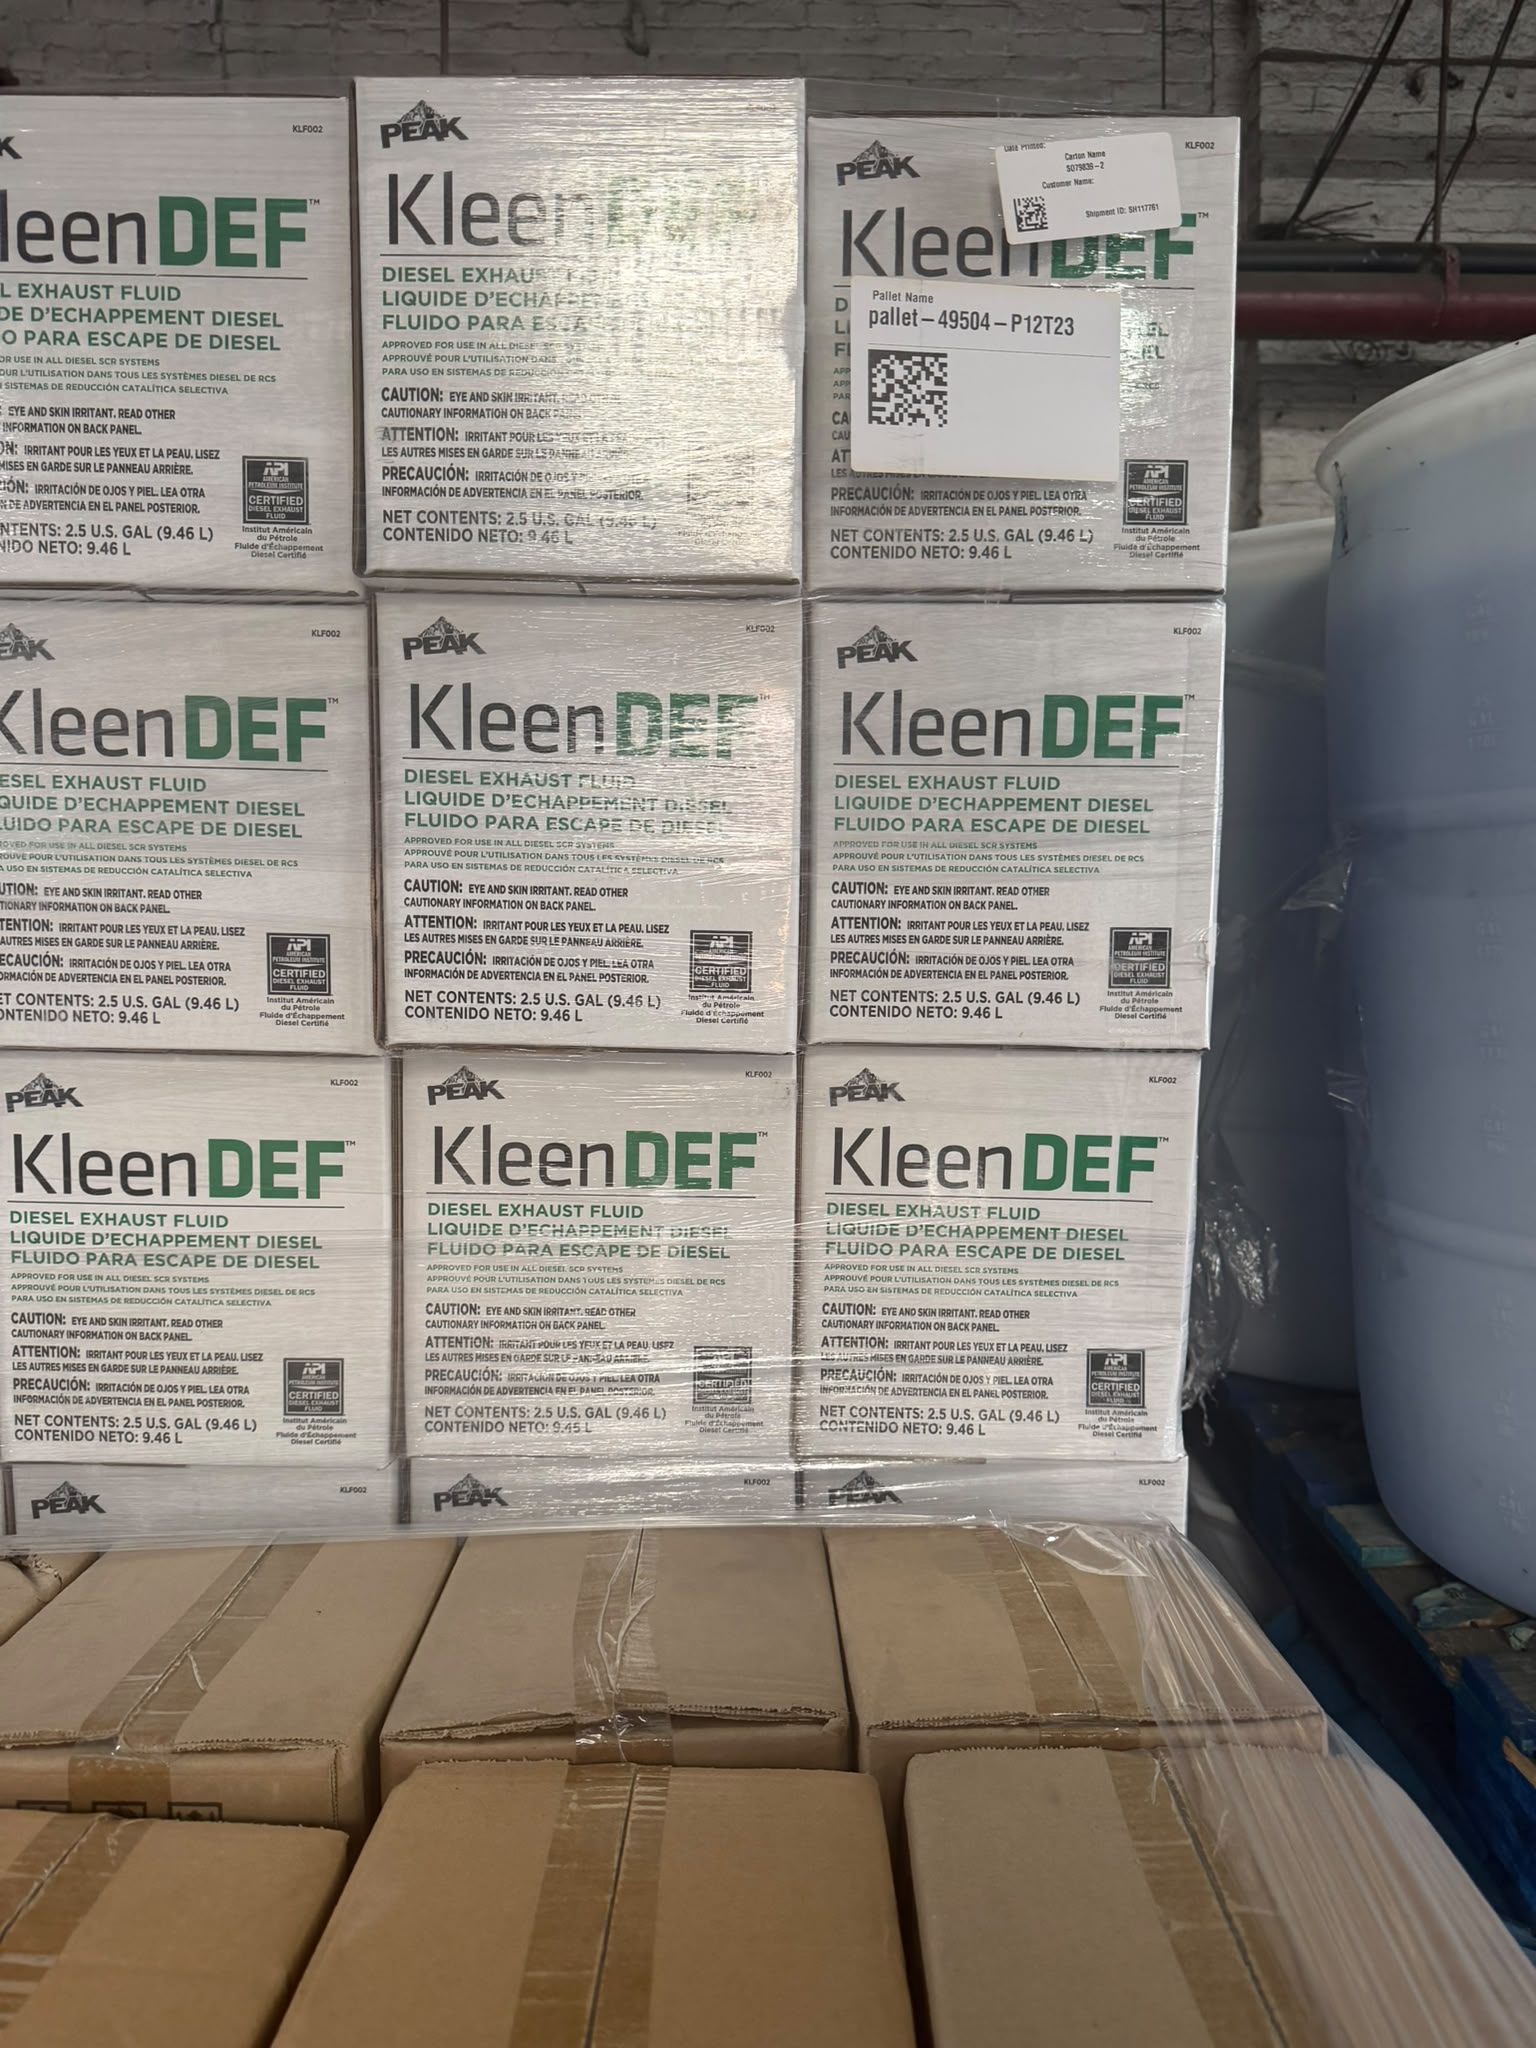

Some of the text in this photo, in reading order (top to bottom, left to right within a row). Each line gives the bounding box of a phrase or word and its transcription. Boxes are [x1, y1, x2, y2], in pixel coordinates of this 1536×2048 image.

[292, 124, 323, 133] KLF002
[380, 114, 469, 149] PEAK
[1184, 141, 1214, 149] KLF002
[1064, 150, 1105, 160] Carton Name
[836, 155, 921, 186] PEAK
[1041, 180, 1071, 189] Customer
[1085, 203, 1159, 218] Shipment ID: SH117761
[382, 266, 454, 282] DIESEL
[17, 283, 180, 301] EXHAUST FLUID
[382, 290, 467, 306] LIQUIDE
[872, 289, 934, 304] Pallet Name
[30, 306, 283, 327] D'ECHAPPEMENT DIESEL
[382, 313, 460, 330] FLUIDO
[467, 314, 525, 331] PARA
[23, 329, 280, 350] PARA ESCAPE DE DIESEL
[380, 386, 443, 401] CAUTION:
[381, 426, 458, 441] ATTENTION:
[264, 462, 288, 476] API
[381, 463, 468, 481] PRECAUCIÓN:
[248, 494, 304, 506] CERTIFIED
[382, 509, 501, 525] NET CONTENTS:
[830, 527, 1094, 546] NET CONTENTS: 2.5 U.S. GAL (9.46 L)
[829, 544, 1012, 559] CONTENIDO NETO: 9.46 L
[311, 629, 340, 637] KLF002
[1173, 627, 1201, 635] KLF002
[402, 631, 487, 660] PEAK
[836, 639, 918, 669] PEAK
[51, 775, 206, 792] EXHAUST FLUID
[404, 769, 572, 788] DIESEL EXHAUST
[834, 774, 1060, 790] DIESEL EXHAUST FLUID
[63, 797, 305, 816] D'ECHAPPEMENT DIESEL
[404, 790, 485, 807] LIQUIDE
[834, 795, 1153, 812] LIQUIDE D'ECHAPPEMENT DIESEL
[57, 817, 302, 838] PARA ESCAPE DE DIESEL
[404, 813, 539, 832] FLUIDO PARA
[834, 816, 1150, 833] FLUIDO PARA ESCAPE DE DIESEL
[891, 864, 932, 872] SISTEMAS
[934, 864, 946, 872] DE
[948, 864, 998, 872] REDUCCIÓN
[1000, 865, 1051, 873] CATALÍTICA
[403, 878, 462, 893] CAUTION:
[831, 881, 1049, 896] CAUTION: EYE AND SKIN IRRITANT. READ OTHER
[830, 898, 1017, 910] CAUTIONARY INFORMATION ON BACK PANEL.
[330, 1078, 358, 1086] KLF002
[745, 1070, 772, 1078] KLF002
[1148, 1075, 1176, 1083] KLF002
[5, 1086, 84, 1113] PEAK
[427, 1079, 505, 1105] PEAK
[829, 1081, 906, 1107] PEAK
[427, 1202, 643, 1218] DIESEL EXHAUST FLUID
[827, 1202, 1040, 1220] DIESEL EXHAUST FLUID
[9, 1210, 228, 1228] DIESEL EXHAUST FLUID
[10, 1230, 322, 1249] LIQUIDE D'ECHAPPEMENT DIESEL
[10, 1249, 319, 1269] FLUIDO PARA ESCAPE DE DIESEL
[288, 1390, 339, 1400] CERTIFIED
[14, 1413, 257, 1432] NET CONTENTS: 2.5 U.S. GAL (9.46 L)
[14, 1428, 182, 1444] CONTENIDO NETO: 9.46 L
[743, 1479, 770, 1487] KLF002
[1138, 1478, 1165, 1486] KLF002
[31, 1493, 106, 1519] PEAK
[433, 1487, 509, 1512] PEAK
